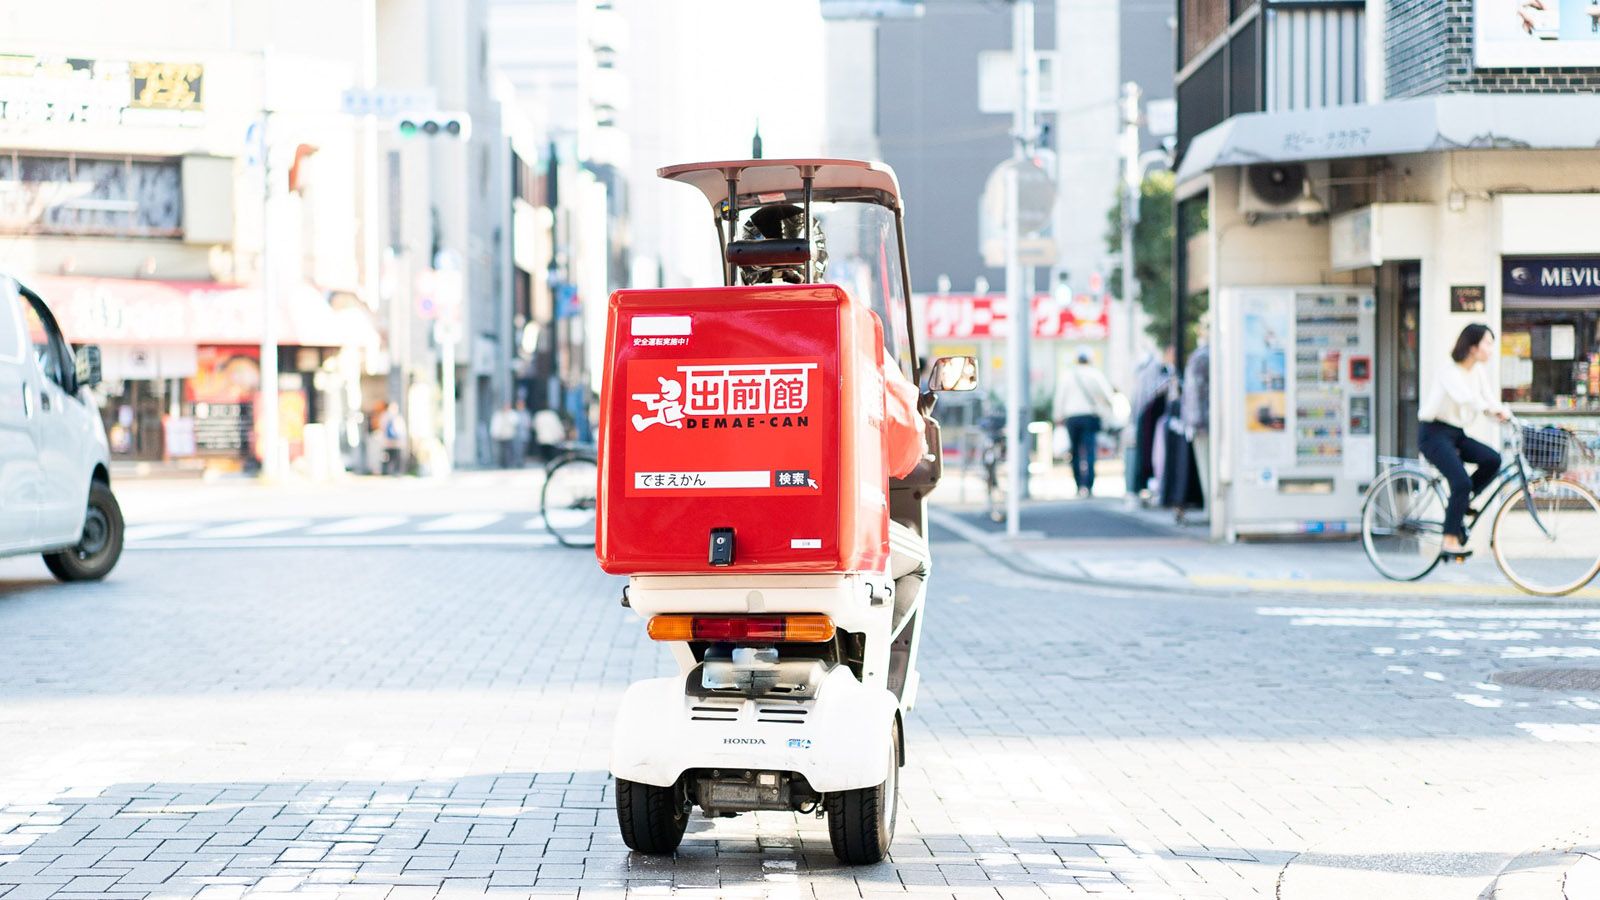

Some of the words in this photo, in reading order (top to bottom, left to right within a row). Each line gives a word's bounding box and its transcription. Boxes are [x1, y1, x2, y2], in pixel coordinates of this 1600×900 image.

[928, 298, 1067, 339] クリーニグ
[690, 377, 804, 411] 出前館
[686, 416, 809, 429] DEMAE-CAN
[640, 473, 706, 487] でまえかん
[778, 472, 804, 486] 検索
